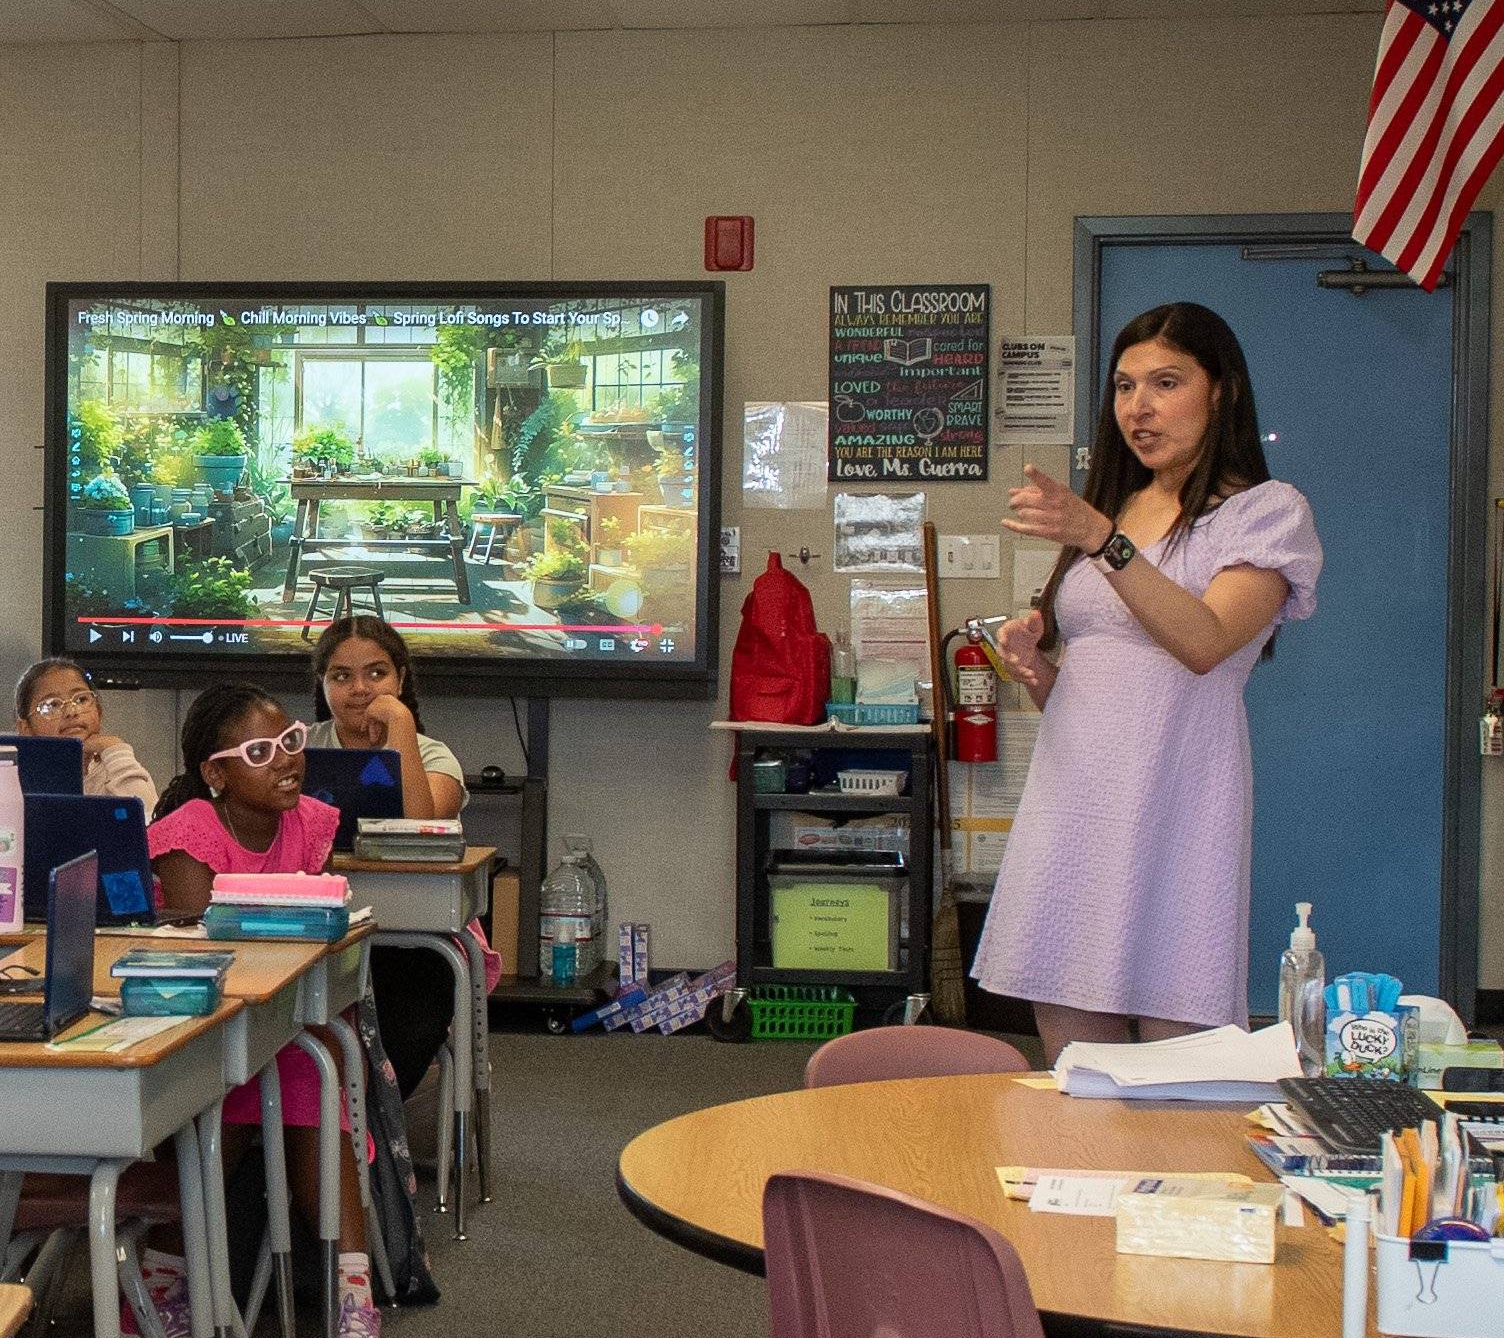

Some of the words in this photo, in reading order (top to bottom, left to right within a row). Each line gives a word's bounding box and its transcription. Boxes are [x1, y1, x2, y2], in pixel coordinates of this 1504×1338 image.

[78, 311, 114, 325] Fresh
[116, 311, 159, 328] Spring
[161, 311, 215, 328] Morning
[241, 311, 270, 325] Chill
[273, 311, 327, 328] Morning
[329, 311, 367, 326] Vibes
[393, 311, 437, 328] Spring
[439, 311, 464, 325] Lofi
[467, 311, 510, 328] Songs
[511, 311, 530, 325] To
[532, 311, 567, 326] Start
[567, 311, 600, 326] Your
[834, 313, 875, 326] ALWAYS
[879, 313, 937, 326] REMEMBER
[941, 312, 960, 325] YOU
[963, 312, 983, 325] ARE
[834, 327, 904, 338] WONDERFUL
[933, 341, 964, 352] cared
[967, 339, 983, 351] for
[1001, 343, 1029, 351] CLUBS
[1029, 343, 1045, 351] ON
[834, 353, 883, 364] unique
[1001, 351, 1040, 359] CAMPUS
[834, 381, 881, 394] LOVED
[947, 402, 983, 414] SMART
[866, 409, 913, 421] WORTHY
[946, 414, 983, 426] BRAVE
[834, 434, 916, 446] AMAZING
[835, 446, 853, 459] YOU
[856, 446, 873, 458] ARE
[876, 446, 892, 458] THE
[895, 446, 933, 459] REASON
[942, 446, 958, 458] AM
[960, 446, 983, 458] HERE
[836, 458, 878, 478] Love,
[883, 457, 913, 477] Ms.
[918, 457, 983, 478] Guerra
[226, 632, 249, 643] LIVE
[810, 898, 849, 907] Journeys
[1350, 1031, 1390, 1046] LUCKY
[1349, 1041, 1389, 1056] DUCK?
